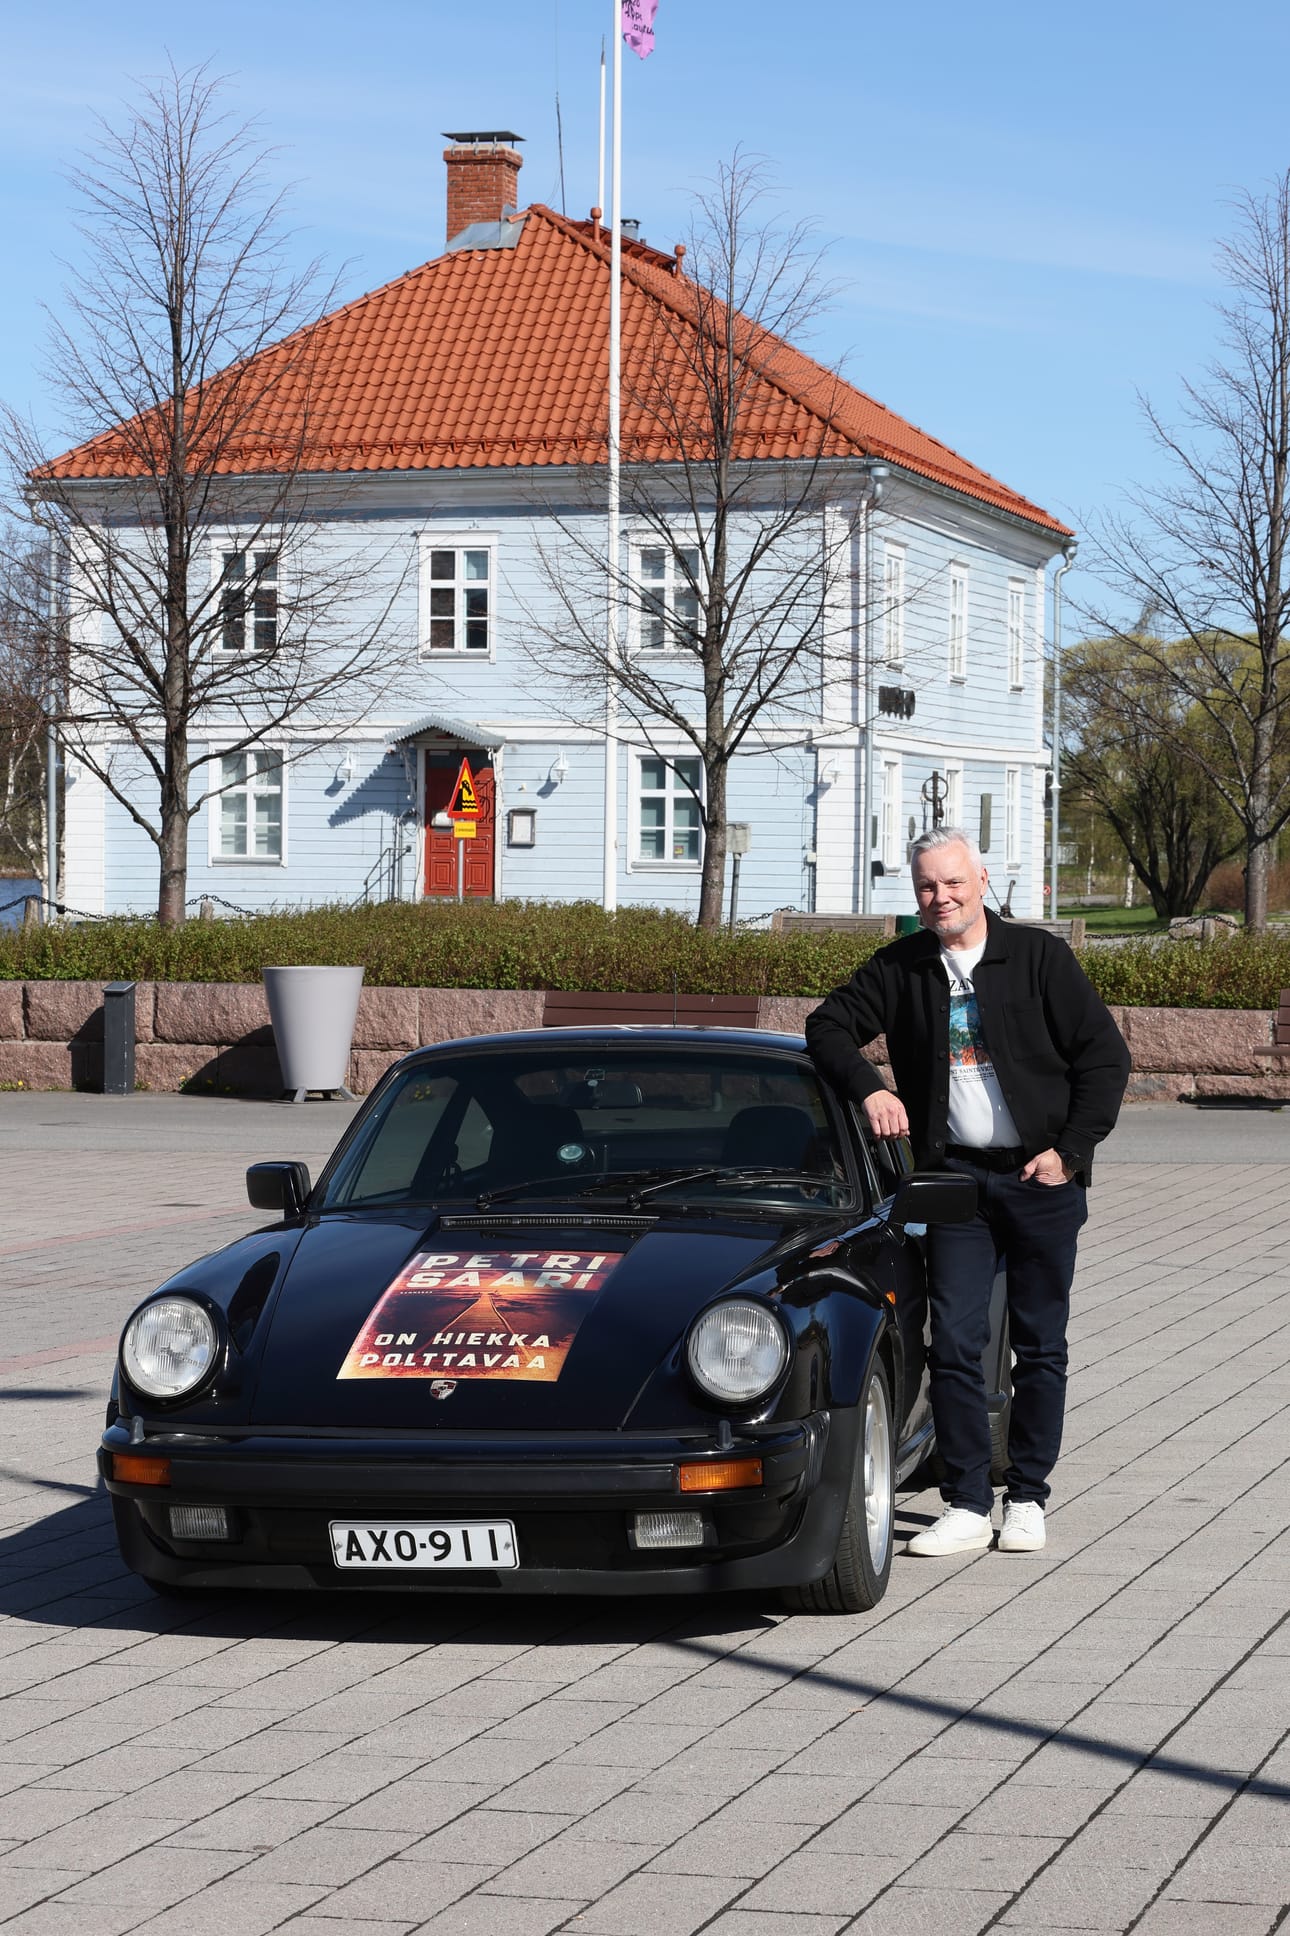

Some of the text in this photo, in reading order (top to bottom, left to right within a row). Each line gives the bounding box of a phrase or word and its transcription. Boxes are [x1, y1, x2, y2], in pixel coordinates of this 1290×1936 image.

[420, 1253, 606, 1270] PETRI
[407, 1271, 594, 1289] SAARI
[374, 1332, 550, 1348] ON HIEKKA
[359, 1353, 545, 1369] POLTTAVAA
[345, 1529, 499, 1562] AXO-911
